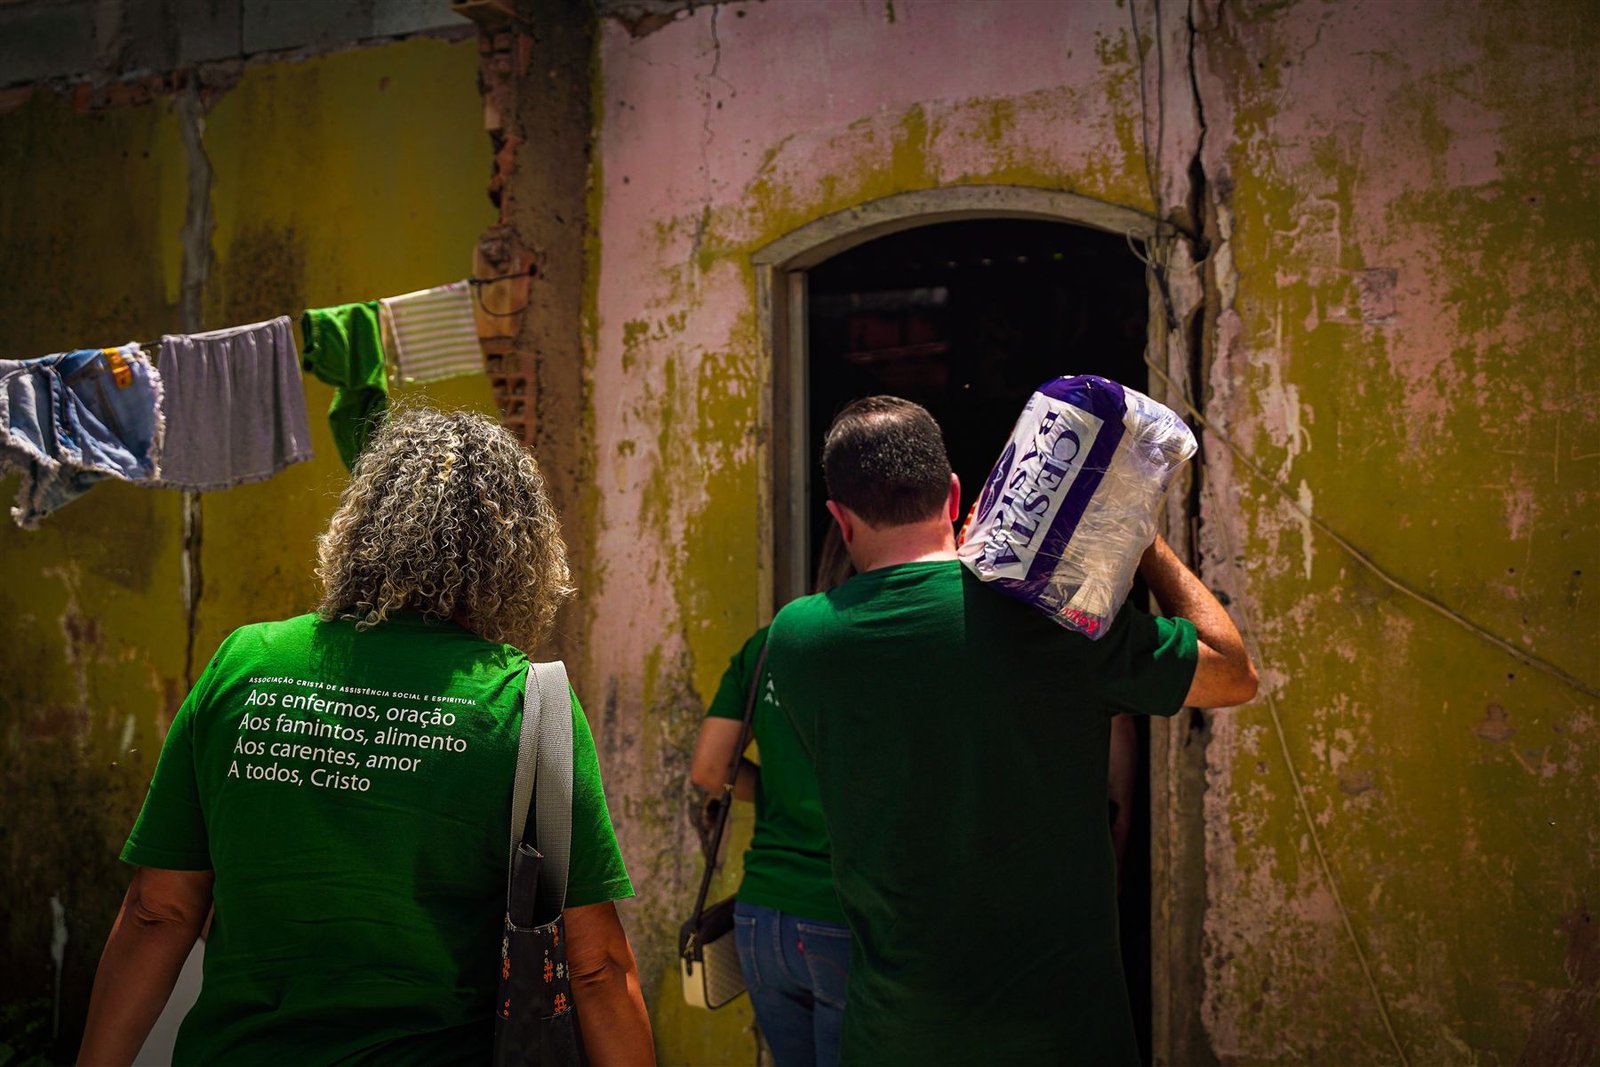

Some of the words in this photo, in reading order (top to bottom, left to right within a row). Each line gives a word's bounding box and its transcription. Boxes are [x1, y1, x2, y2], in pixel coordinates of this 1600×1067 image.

[993, 429, 1080, 566] CESTA
[244, 689, 278, 707] Aos
[281, 693, 380, 722] enfermos,
[386, 707, 456, 729] oração
[249, 676, 294, 685] ASSOCIAÇÃO
[296, 679, 324, 689] CRISTÃ
[339, 686, 390, 697] ASSISTÊNCIA
[392, 691, 421, 701] SOCIAL
[431, 695, 477, 706] ESPIRITUAL
[238, 712, 271, 731] Aos
[275, 713, 369, 746] famintos,
[374, 726, 467, 752] alimento
[233, 736, 266, 756] Aos
[269, 742, 360, 769] carentes,
[365, 753, 422, 772] amor
[227, 760, 240, 779] A
[245, 762, 304, 787] todos,
[310, 768, 371, 792] Cristo
